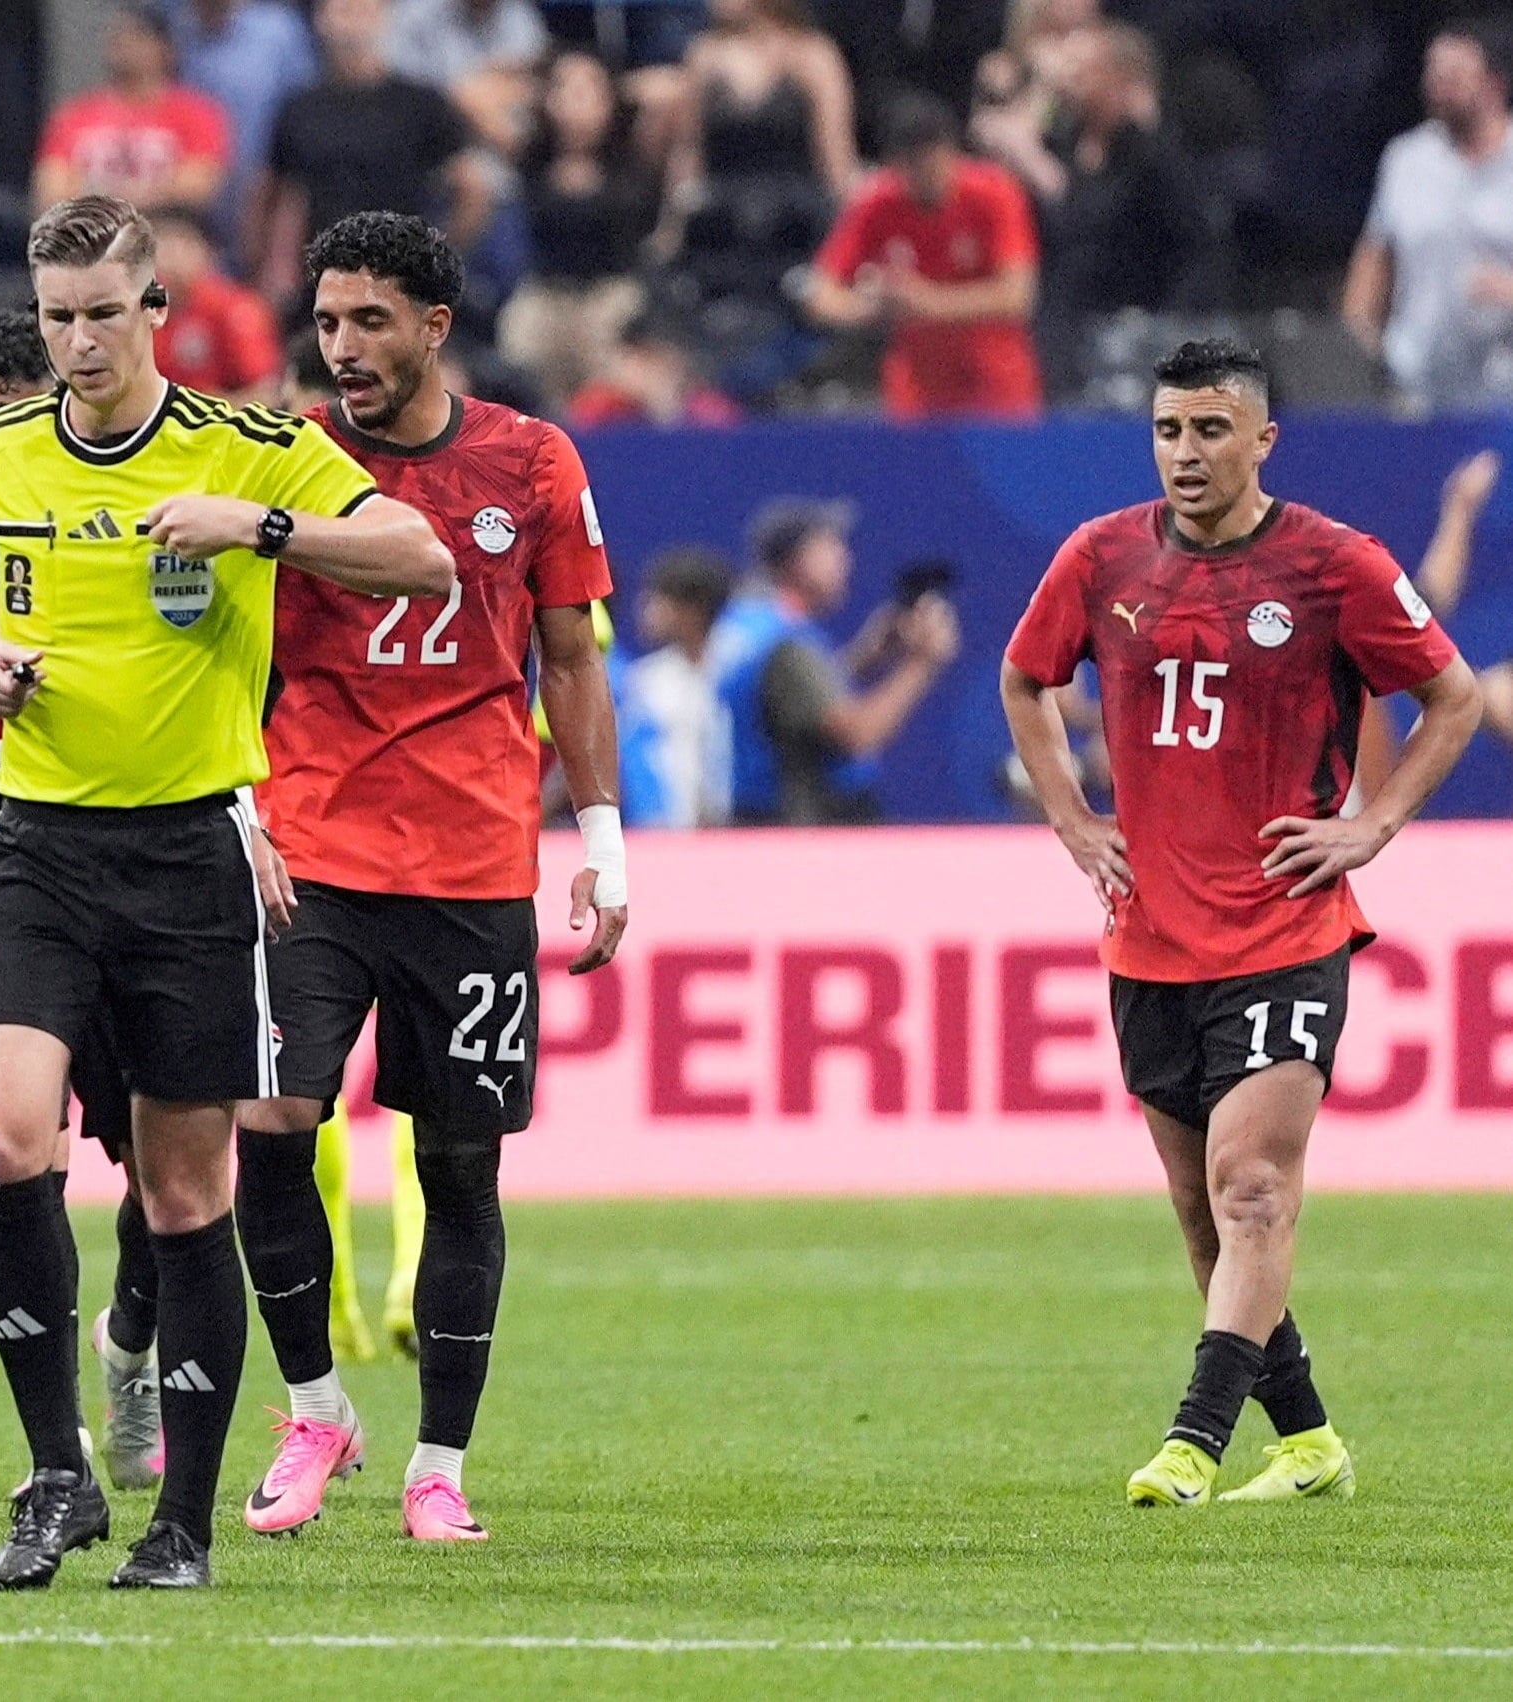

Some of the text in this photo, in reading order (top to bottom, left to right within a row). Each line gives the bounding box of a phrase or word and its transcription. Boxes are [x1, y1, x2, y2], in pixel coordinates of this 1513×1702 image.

[154, 584, 208, 597] REFEREE
[155, 555, 208, 574] FIFA
[367, 574, 463, 665] 22
[1153, 658, 1230, 750] 15
[449, 971, 528, 1062] 22
[1244, 1000, 1328, 1069] 15
